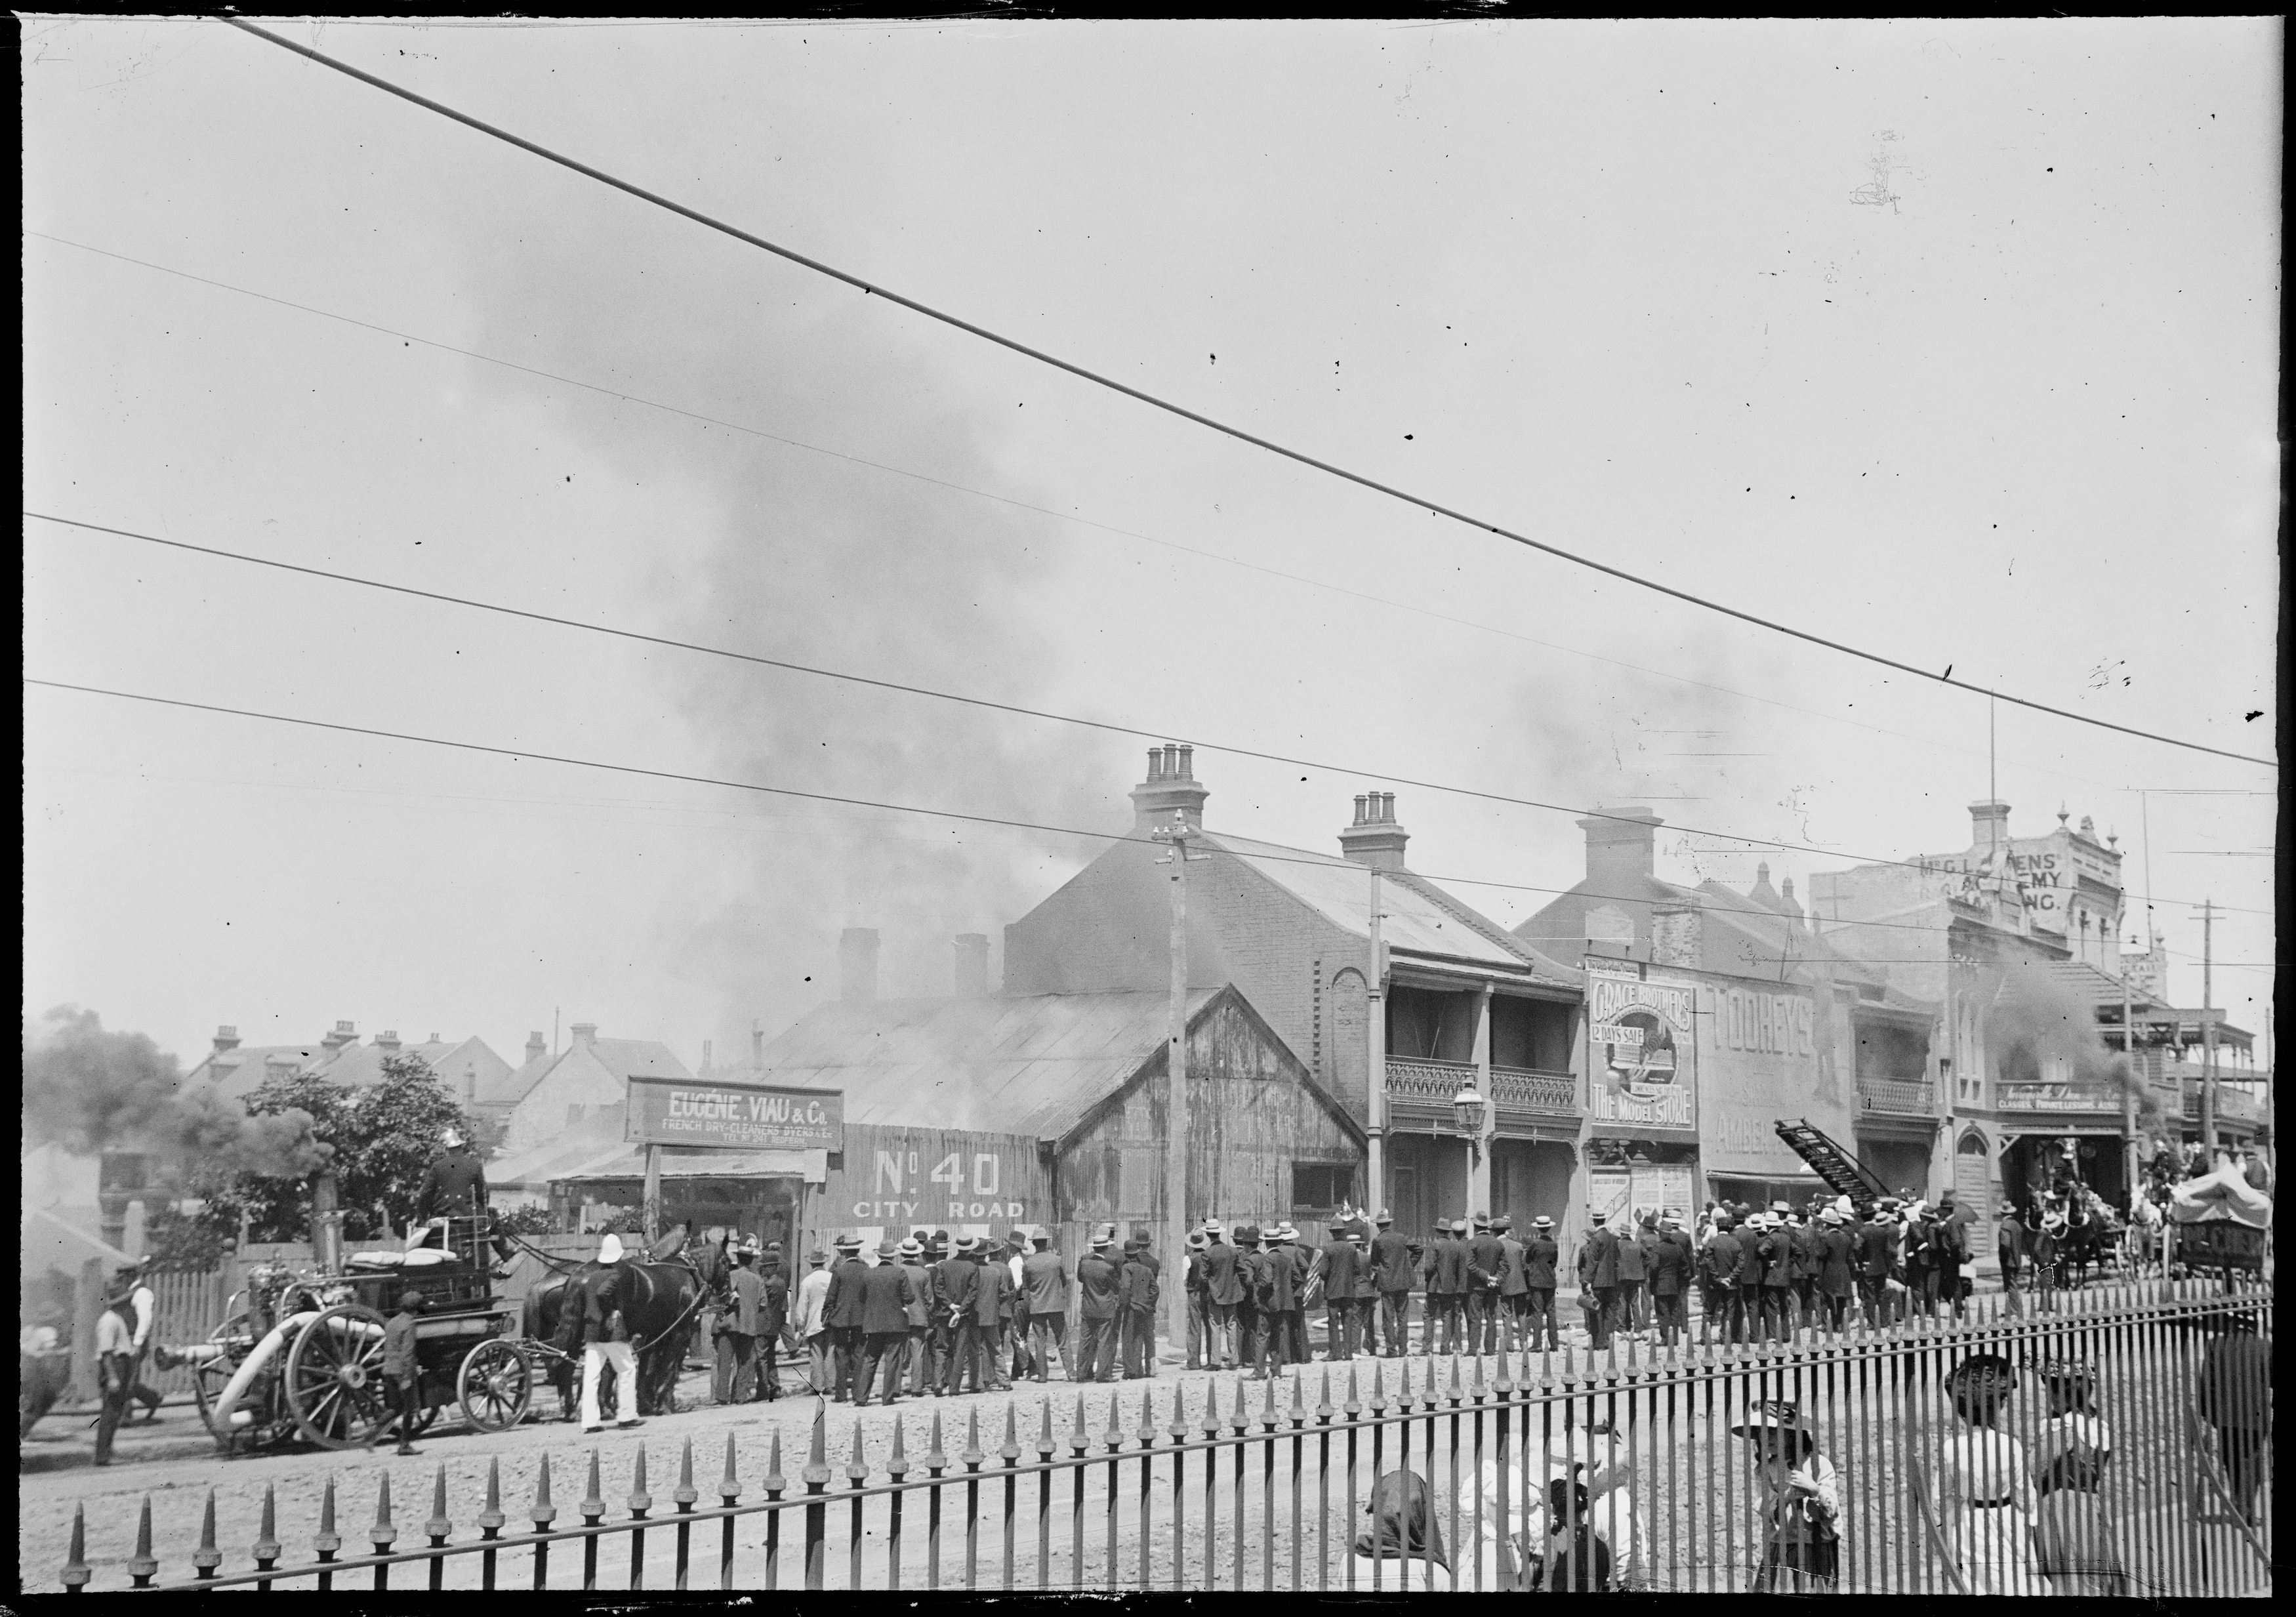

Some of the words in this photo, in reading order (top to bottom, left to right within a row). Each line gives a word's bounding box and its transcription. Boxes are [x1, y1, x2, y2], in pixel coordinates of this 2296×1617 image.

[1593, 981, 1635, 1022] GRACE
[1639, 985, 1691, 1032] BROTHERS
[1592, 1026, 1600, 1041] 12
[1601, 1027, 1622, 1042] DAYS
[1624, 1029, 1643, 1044] SALE
[749, 1096, 790, 1124] VIAU
[791, 1107, 806, 1124] &
[1618, 1095, 1653, 1122] MODEL
[1655, 1090, 1691, 1124] STORE
[662, 1118, 702, 1131] FRENCH
[930, 1152, 999, 1195] 40
[853, 1201, 918, 1218] CITY
[949, 1202, 1025, 1218] ROAD
